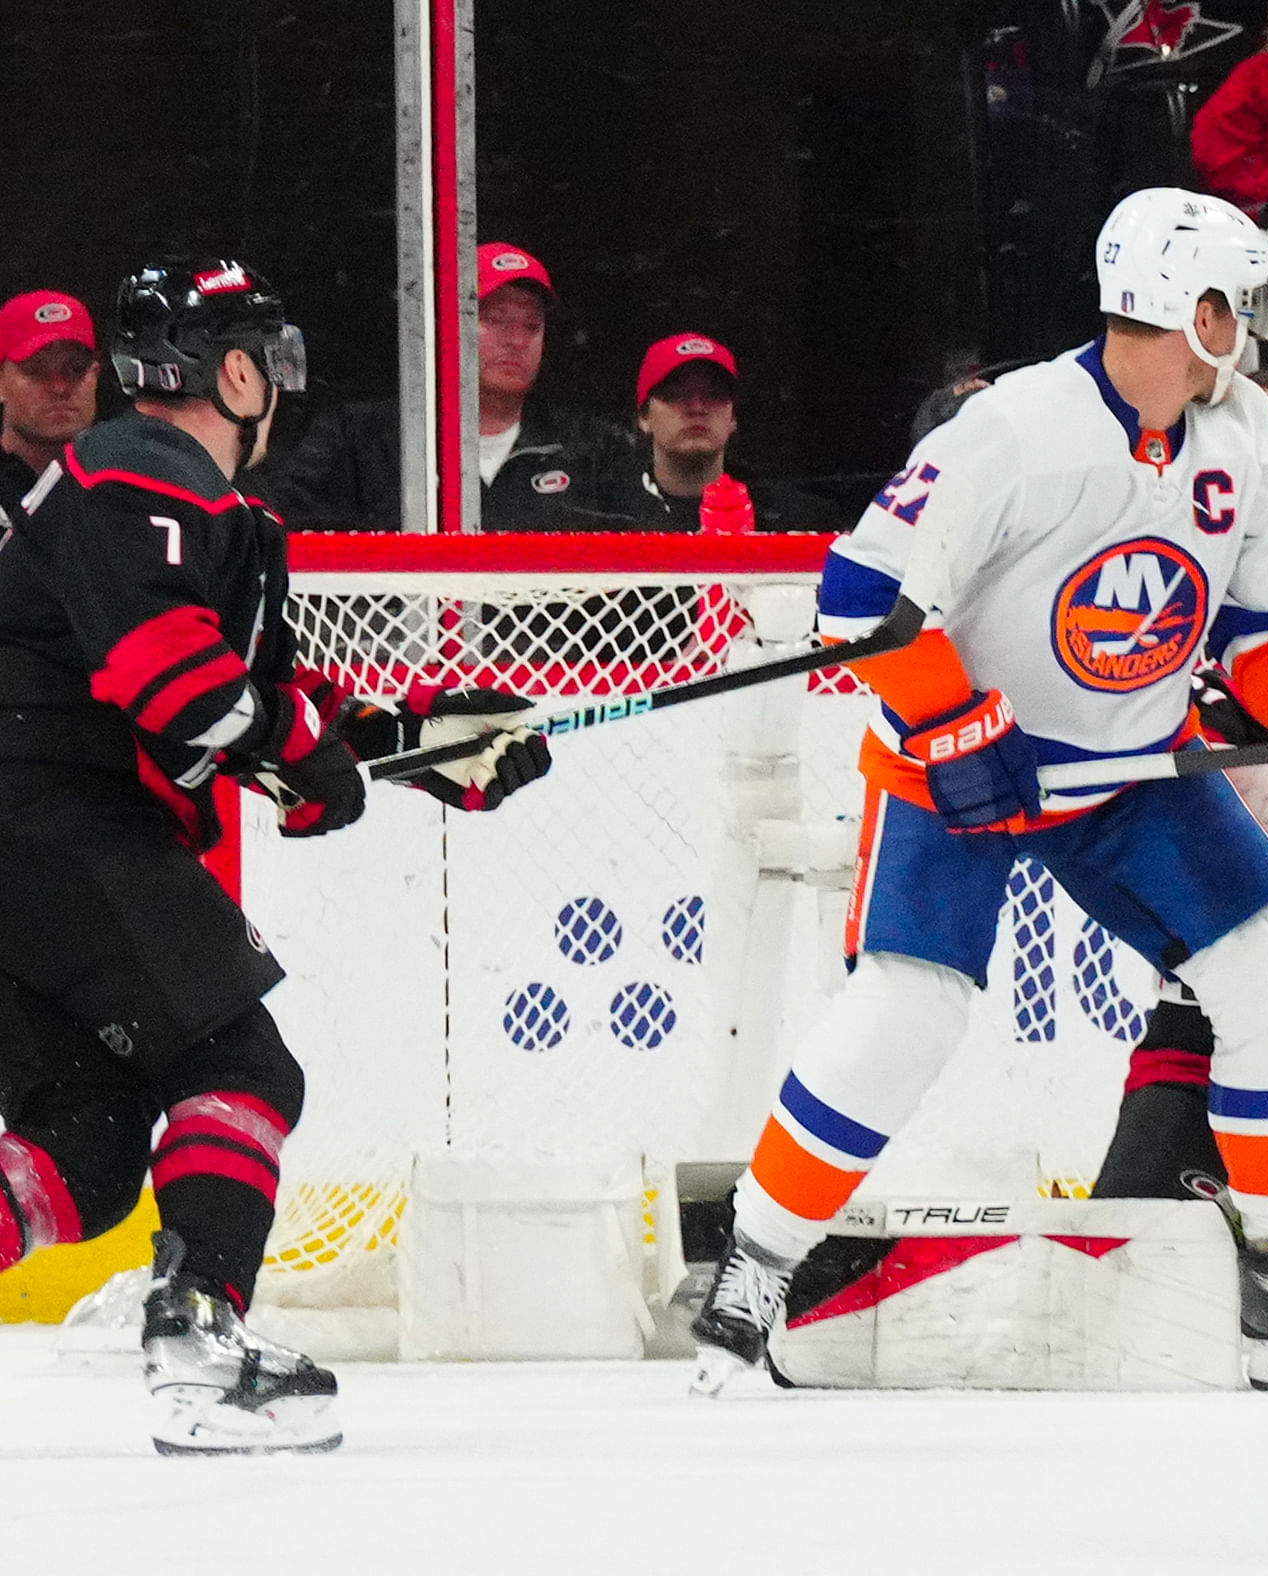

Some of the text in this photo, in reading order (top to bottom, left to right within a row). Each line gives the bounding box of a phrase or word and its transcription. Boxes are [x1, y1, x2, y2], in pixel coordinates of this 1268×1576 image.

[1104, 242, 1121, 264] 27
[874, 463, 943, 527] 27
[1193, 470, 1236, 535] C
[149, 515, 182, 565] 7
[894, 1205, 1010, 1225] TRUE
